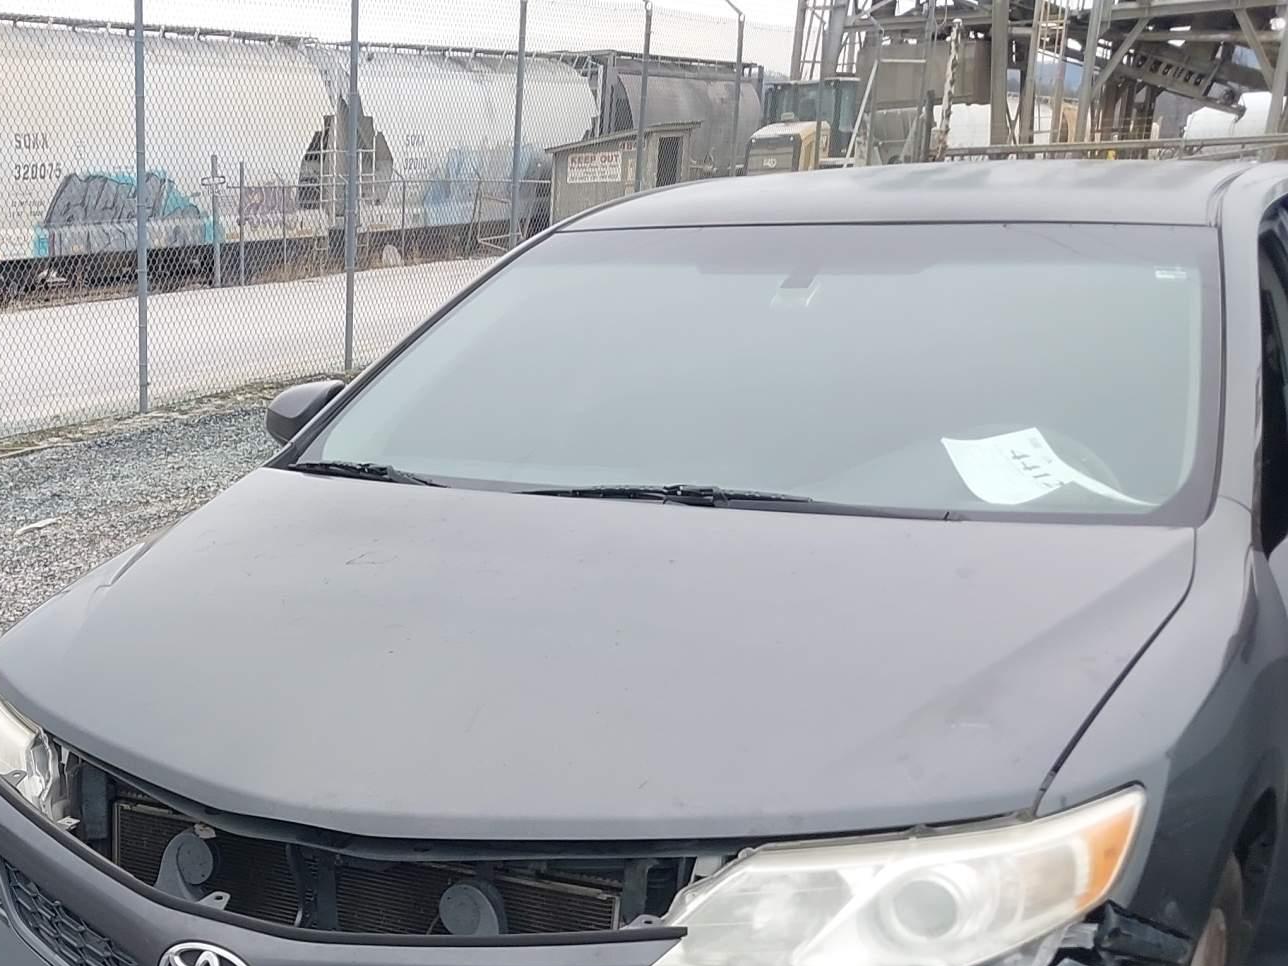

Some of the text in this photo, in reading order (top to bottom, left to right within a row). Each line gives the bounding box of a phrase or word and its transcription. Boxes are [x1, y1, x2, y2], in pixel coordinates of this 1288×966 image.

[570, 153, 620, 165] KEEP OUT
[14, 162, 62, 180] 320075
